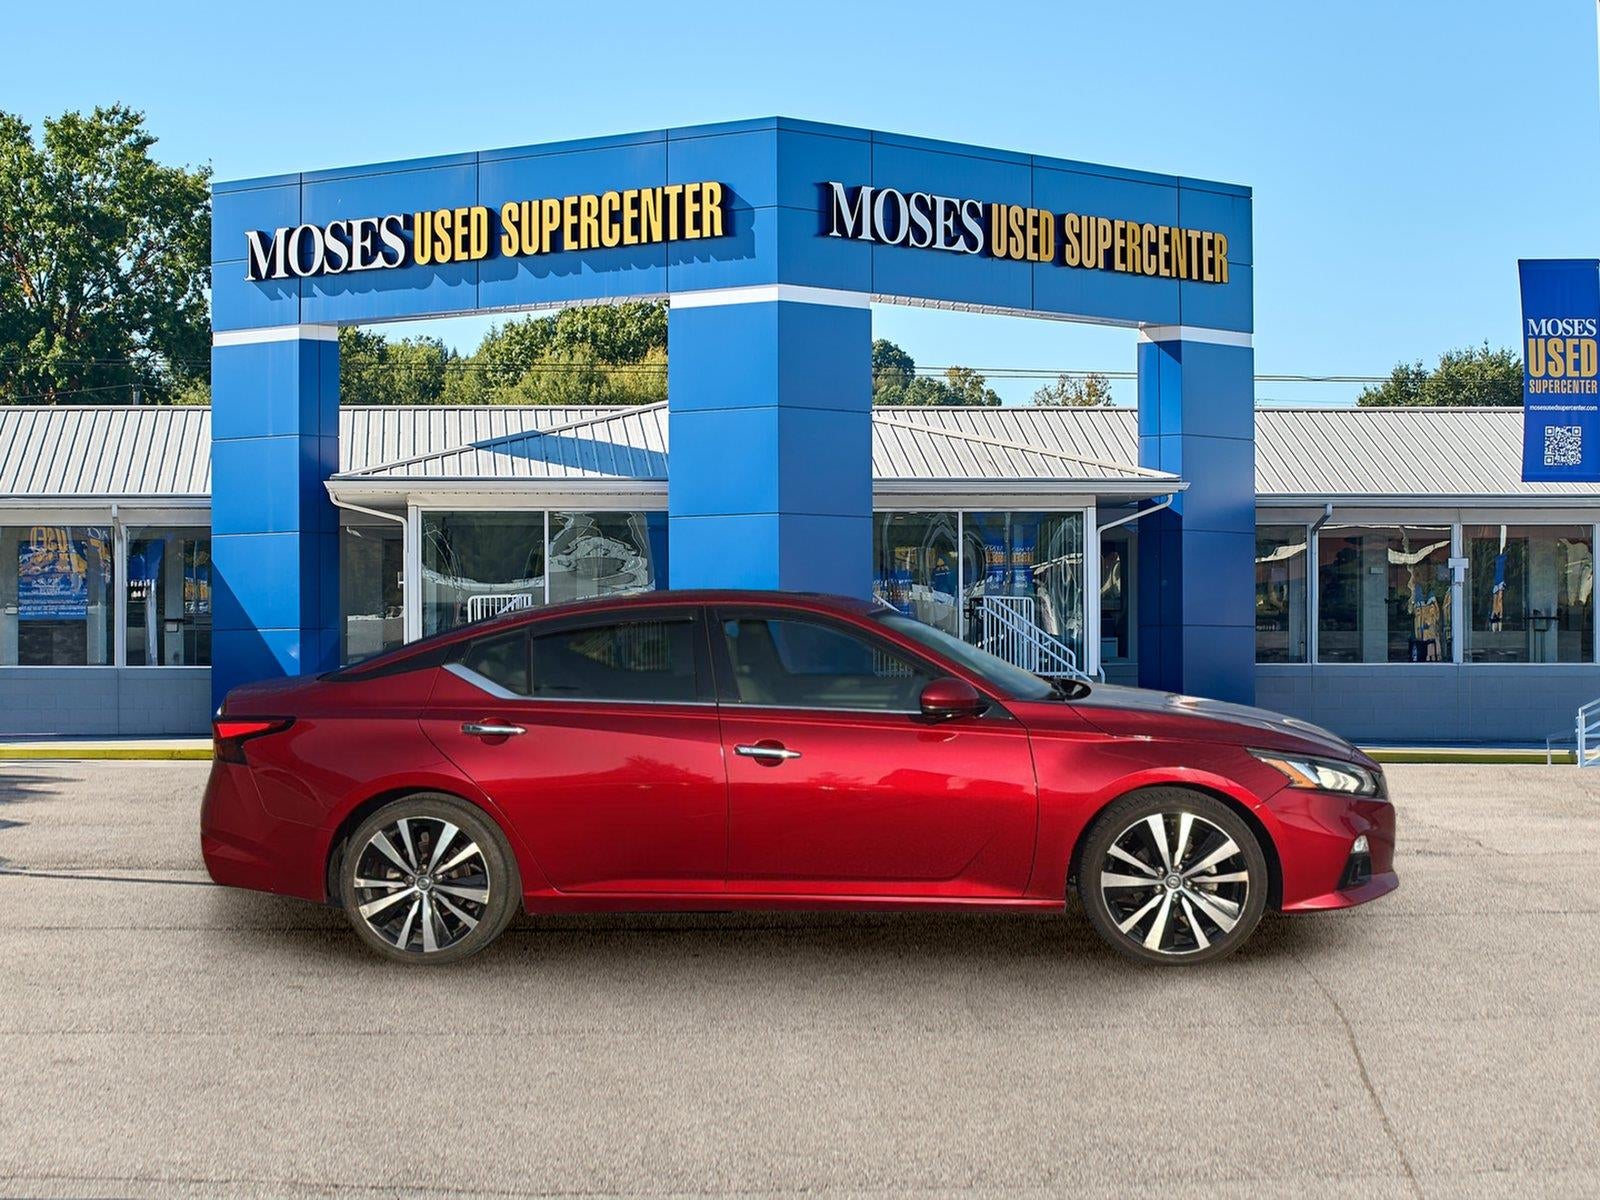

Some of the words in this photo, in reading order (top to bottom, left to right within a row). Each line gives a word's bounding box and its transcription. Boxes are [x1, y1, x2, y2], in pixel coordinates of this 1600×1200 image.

[243, 213, 407, 282] MOSES
[412, 205, 489, 266] USED
[500, 181, 724, 258] SUPERCENTER
[828, 181, 985, 255] MOSES
[991, 203, 1055, 263] USED
[1064, 212, 1229, 284] SUPERCENTER
[1527, 318, 1597, 337] MOSES
[1528, 338, 1598, 377] USED
[1529, 379, 1598, 394] SUPERCENTER
[1529, 404, 1598, 412] mosesusedsupercenter.com
